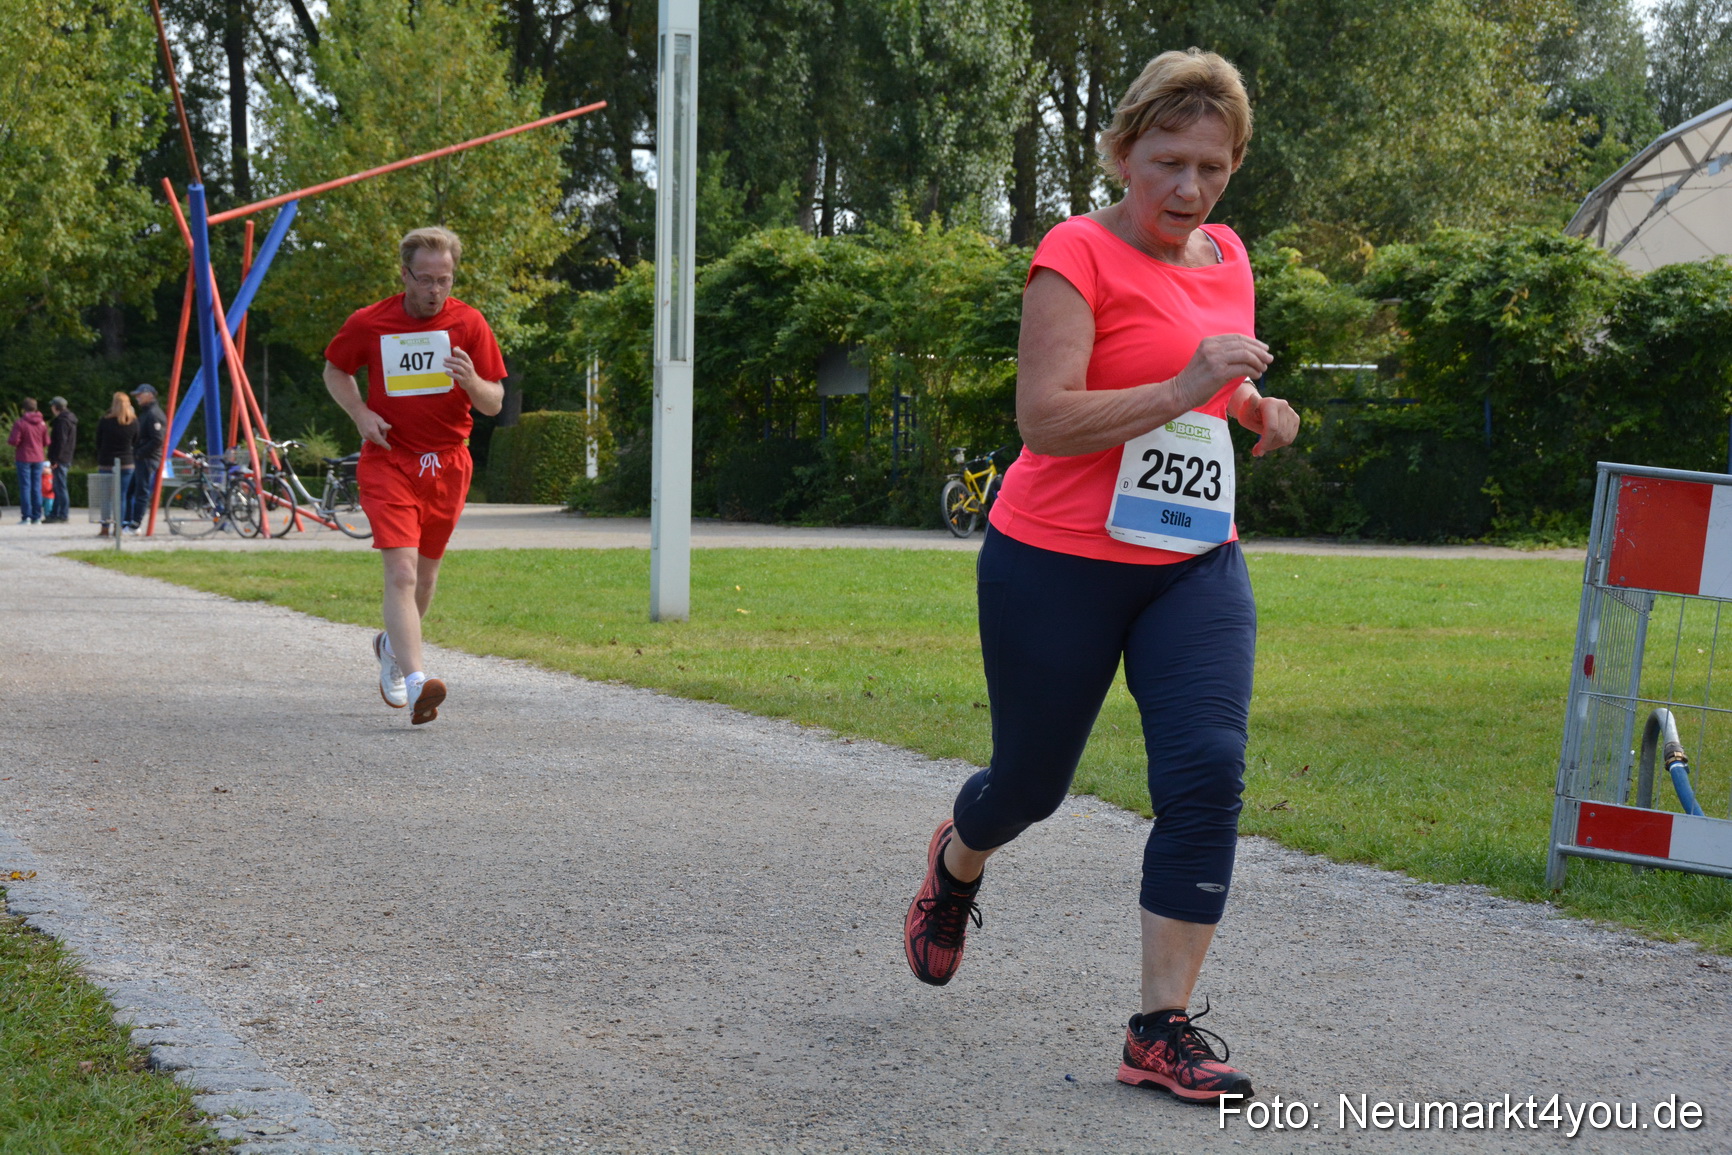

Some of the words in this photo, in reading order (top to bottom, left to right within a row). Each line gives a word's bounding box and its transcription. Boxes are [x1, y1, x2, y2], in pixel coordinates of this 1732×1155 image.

[400, 352, 434, 371] 407
[1176, 422, 1211, 440] BOCK
[1137, 449, 1221, 501] 2523
[1123, 481, 1129, 489] D
[1161, 510, 1192, 528] Stilla
